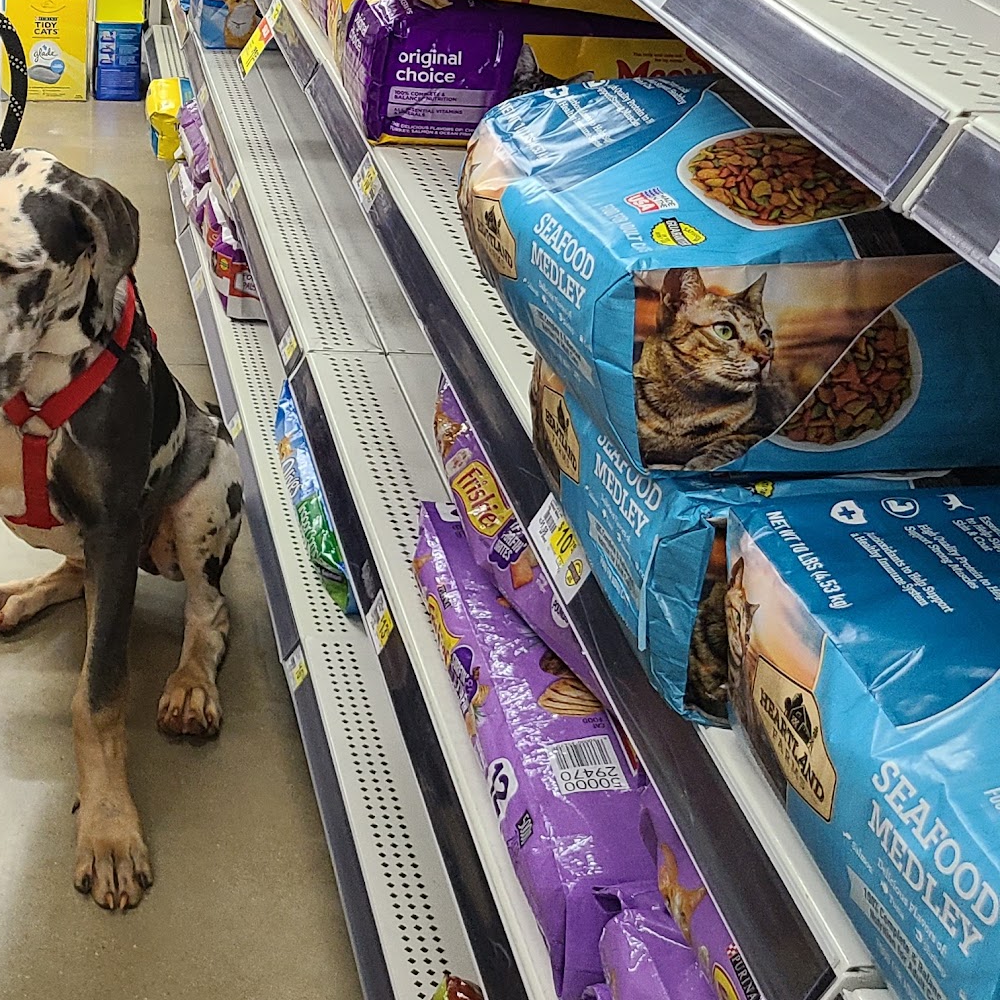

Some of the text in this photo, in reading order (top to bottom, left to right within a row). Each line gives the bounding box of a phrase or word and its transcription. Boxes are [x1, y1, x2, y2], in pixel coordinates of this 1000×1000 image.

[34, 21, 58, 29] TIDY
[33, 49, 58, 62] glade
[395, 67, 456, 83] choice
[398, 48, 463, 68] original
[533, 212, 596, 281] SEAFOOD
[531, 241, 586, 311] MEDLEY
[456, 466, 504, 529] Friskie
[594, 453, 650, 540] MEDLEY
[766, 510, 786, 532] NET
[780, 526, 798, 545] WT
[799, 550, 824, 573] LBS
[855, 536, 929, 607] Healthy Immune System
[863, 532, 954, 613] Antioxidants to Help Support
[904, 525, 979, 589] Support Strong Muscles
[917, 523, 939, 537] High
[934, 535, 961, 557] Quality
[955, 556, 983, 579] Protein
[811, 569, 842, 597] (4.53
[832, 593, 853, 611] kg)
[759, 688, 825, 803] HEARTLAND
[558, 765, 618, 783] 29470
[563, 777, 623, 793] 50000
[871, 759, 1000, 926] SEAFOOD
[867, 800, 984, 958] MEDLEY
[732, 953, 763, 1000] PURINA
